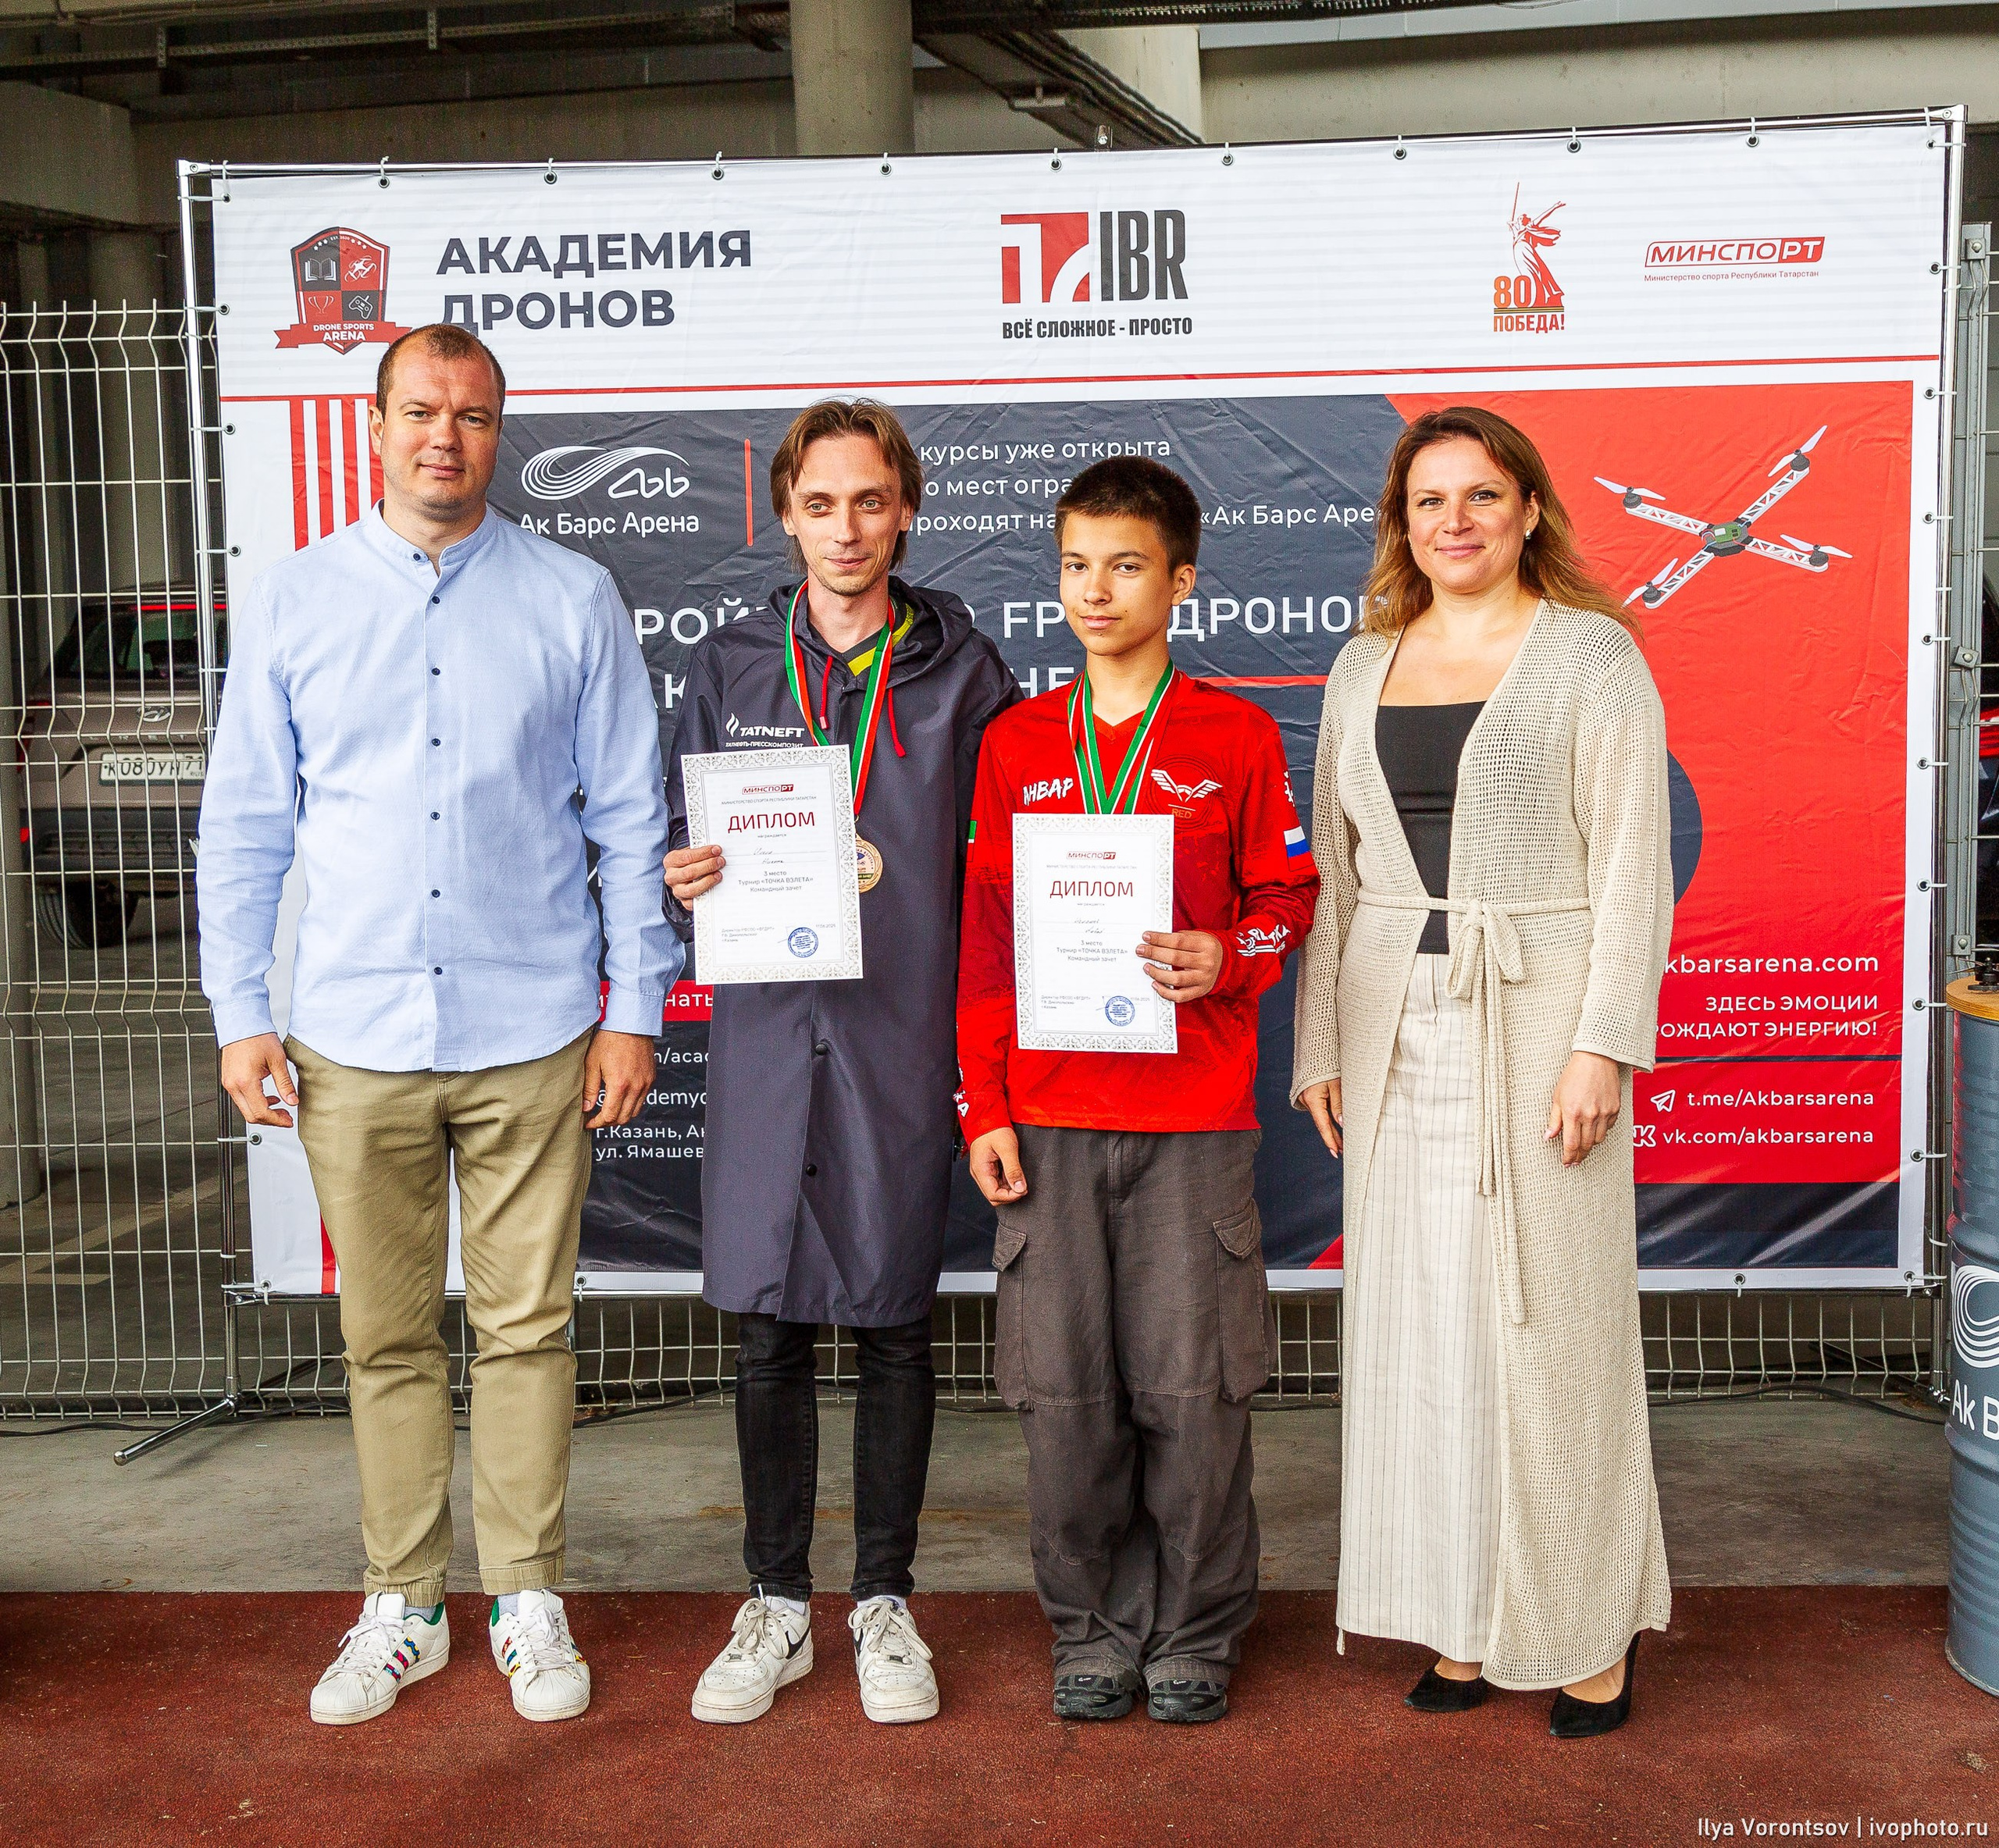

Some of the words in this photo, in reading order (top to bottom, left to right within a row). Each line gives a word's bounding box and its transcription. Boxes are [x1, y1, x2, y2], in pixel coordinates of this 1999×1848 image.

[436, 230, 751, 279] АКАДЕМИЯ
[1099, 209, 1188, 302] IBR
[1650, 240, 1822, 264] МИНСПОРТ
[1644, 273, 1701, 283] Министерство
[1701, 272, 1729, 282] спорта
[1730, 272, 1777, 280] Республики
[1779, 270, 1819, 279] Татарстан
[1493, 274, 1532, 308] 80
[442, 289, 675, 337] ДРОНОВ
[313, 323, 342, 332] DRONE
[343, 322, 375, 331] SPORTS
[1002, 318, 1033, 339] ВСЁ
[1036, 319, 1116, 338] СЛОЖНОЕ
[1128, 317, 1193, 336] ПРОСТО
[1493, 313, 1565, 334] ПОБЕДА!
[322, 331, 366, 341] ARENA
[919, 443, 1000, 466] курсы
[1004, 443, 1056, 465] уже
[1061, 440, 1171, 459] открыта
[946, 479, 1009, 497] мест
[519, 513, 551, 536] Ак
[557, 512, 617, 539] Барс
[622, 511, 700, 538] Арена
[1252, 504, 1317, 529] Барс
[1323, 504, 1381, 528] Аре
[739, 725, 805, 738] TATNEFT
[743, 784, 793, 794] МИНСПОРТ
[727, 811, 815, 834] ДИПЛОМ
[1049, 880, 1133, 899] ДИПЛОМ
[1663, 954, 1880, 974] kbarsarena.com
[1705, 995, 1776, 1013] ЗДЕСЬ
[1780, 995, 1878, 1013] ЭМОЦИИ
[1655, 1021, 1760, 1040] ОЖДАЮТ
[1764, 1020, 1877, 1037] ЭНЕРГИЮ!
[1687, 1088, 1875, 1108] t.me/Akbarsarena
[596, 1125, 682, 1141] г.Казань,
[1662, 1127, 1874, 1145] vk.com/akbarsarena
[595, 1148, 623, 1162] ул.
[1951, 1379, 1976, 1431] Ak
